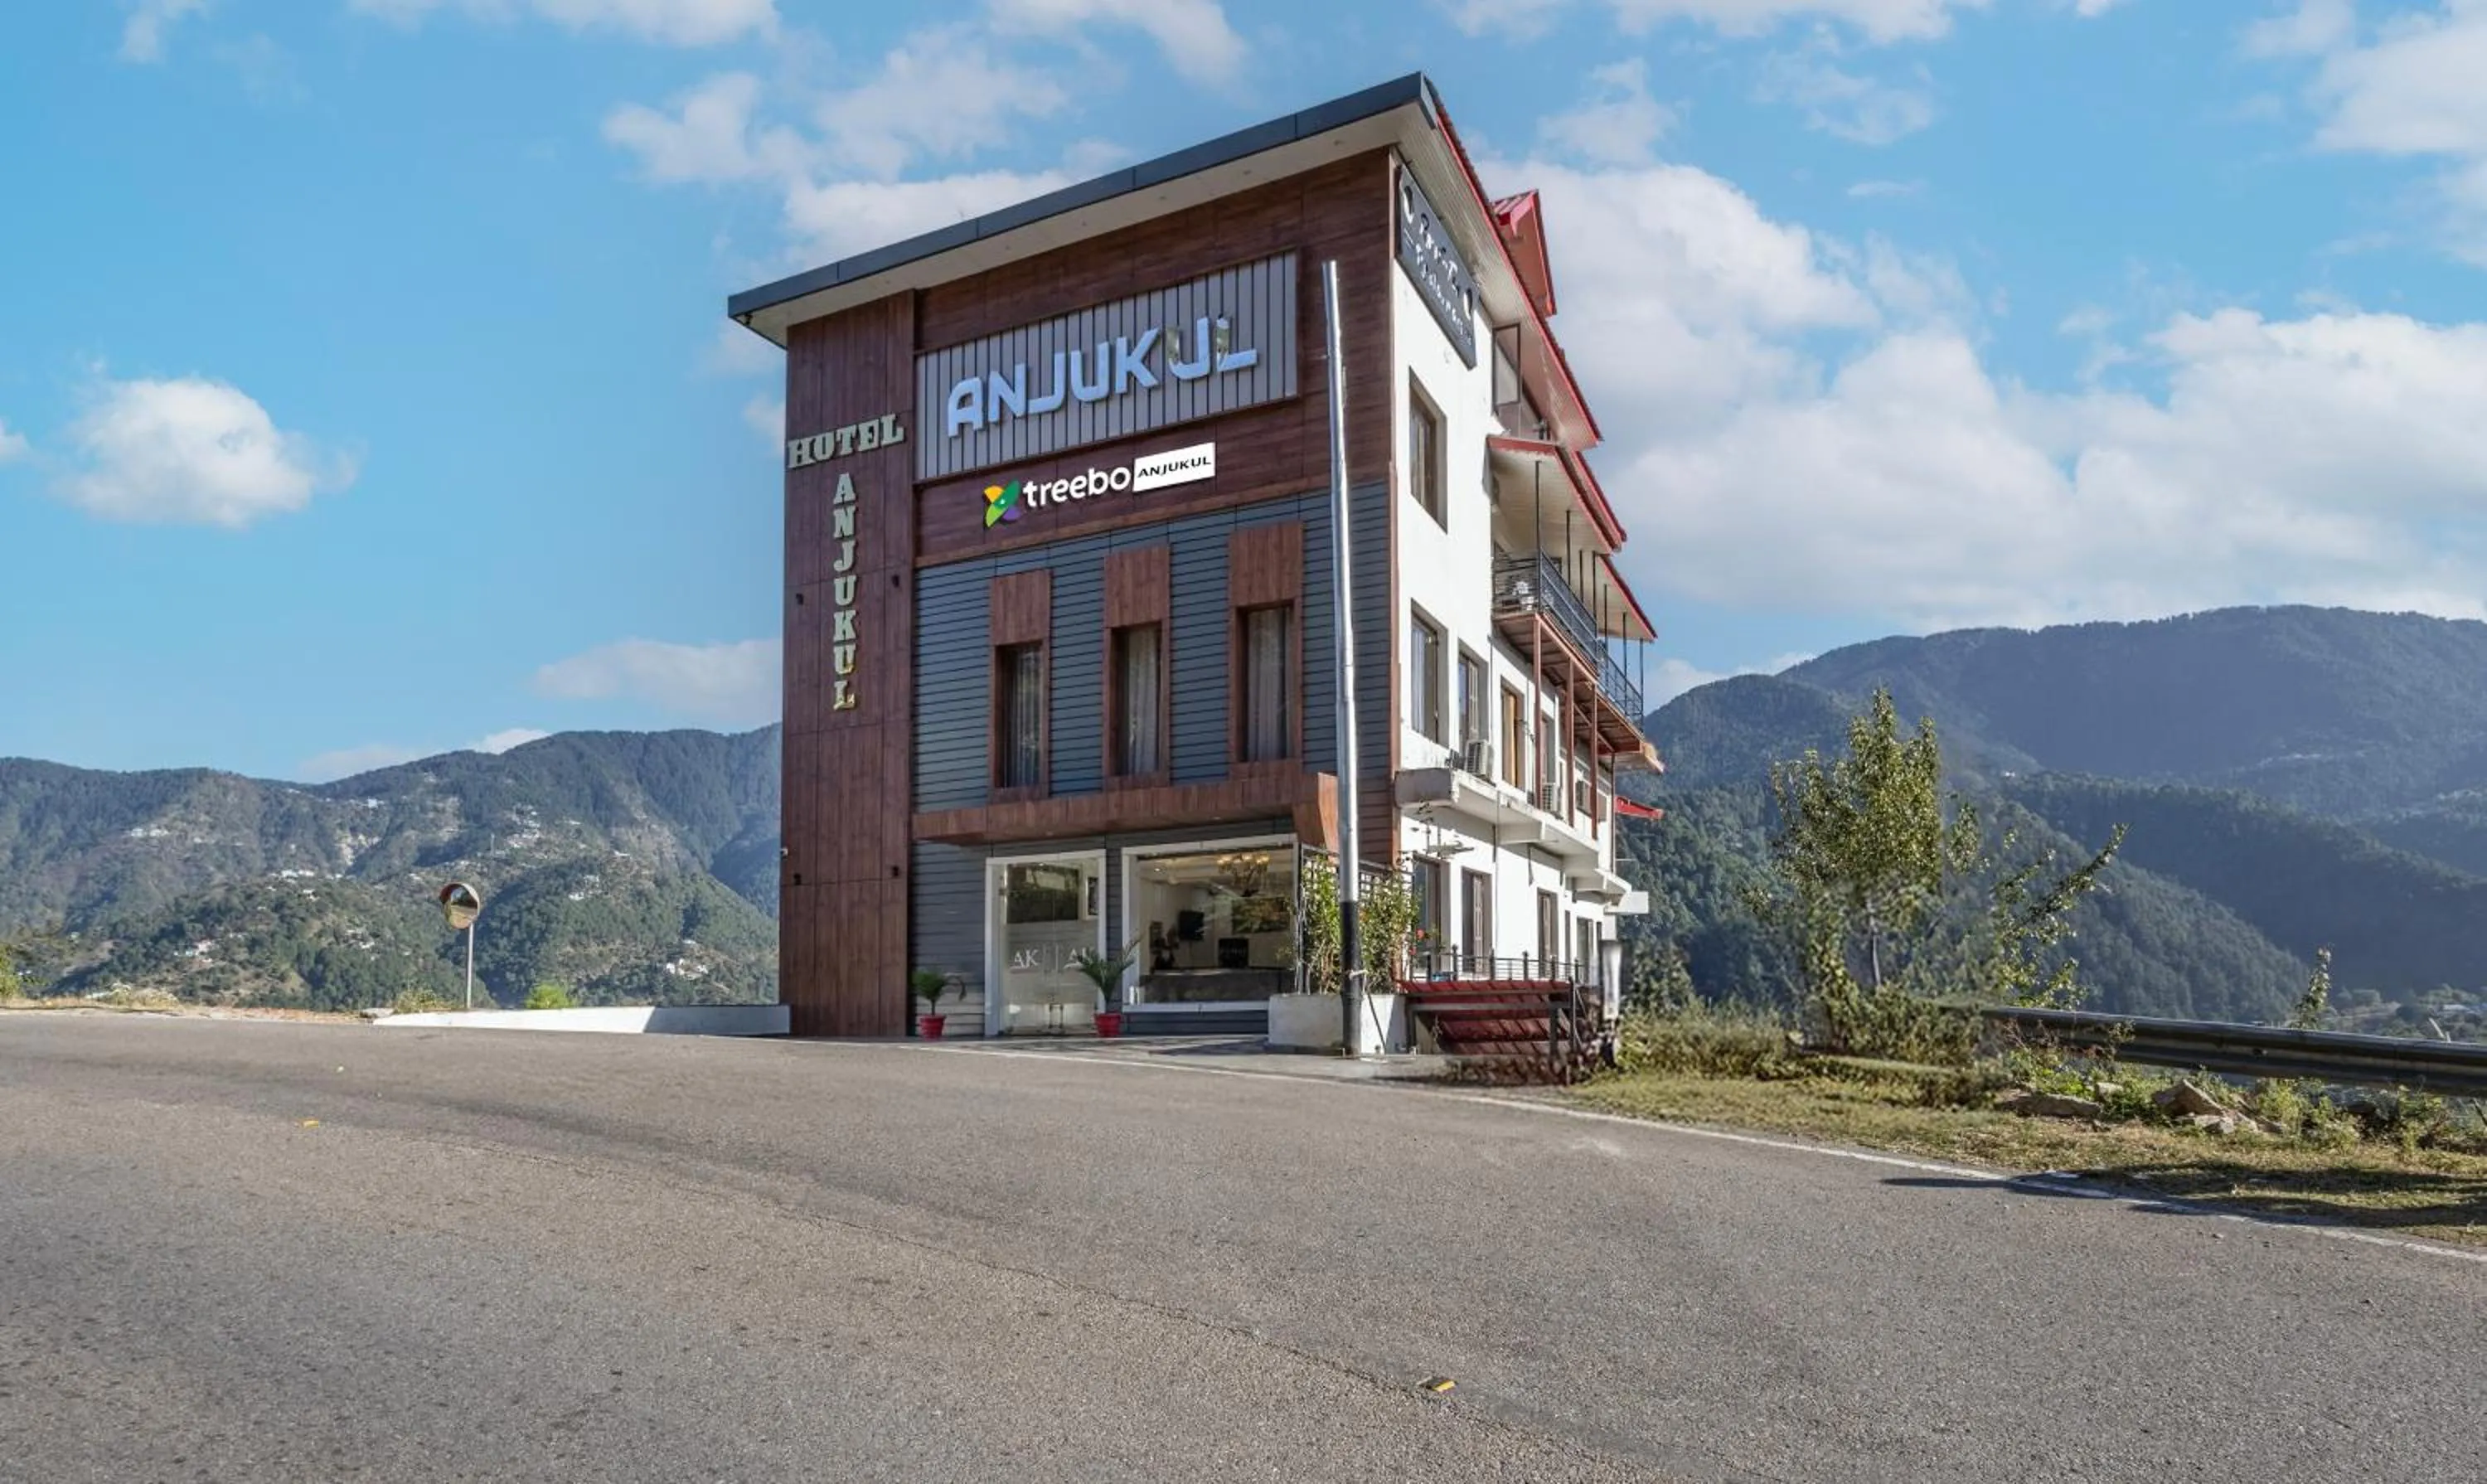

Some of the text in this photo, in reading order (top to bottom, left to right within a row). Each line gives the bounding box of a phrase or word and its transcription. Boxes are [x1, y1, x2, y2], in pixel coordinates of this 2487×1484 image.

[947, 317, 1258, 438] ANJUKUL
[788, 414, 905, 468] HOTEL
[1023, 455, 1212, 508] treebo ANJUKUL
[832, 472, 857, 710] ANJUKUL
